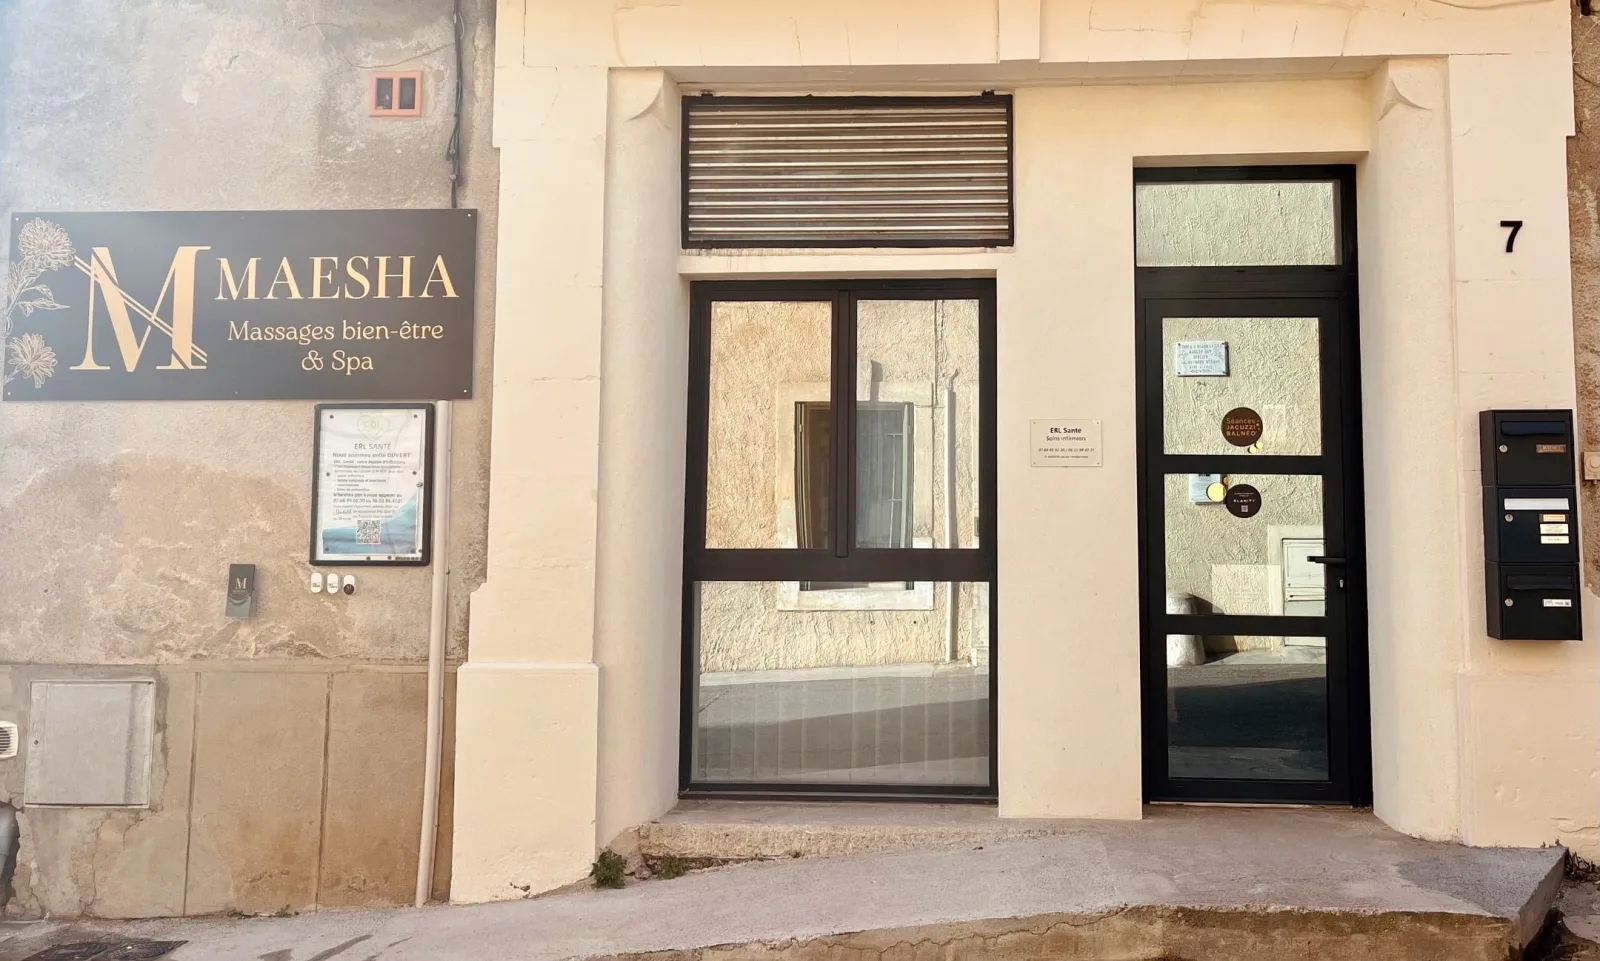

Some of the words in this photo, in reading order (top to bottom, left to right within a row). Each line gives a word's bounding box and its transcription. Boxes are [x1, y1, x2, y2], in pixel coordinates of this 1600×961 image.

[1500, 220, 1523, 253] 7
[214, 254, 460, 301] MAESHA
[70, 246, 211, 373] M
[227, 320, 335, 346] Massages
[342, 319, 444, 341] bien-être
[301, 350, 324, 371] &
[331, 349, 374, 376] Spa
